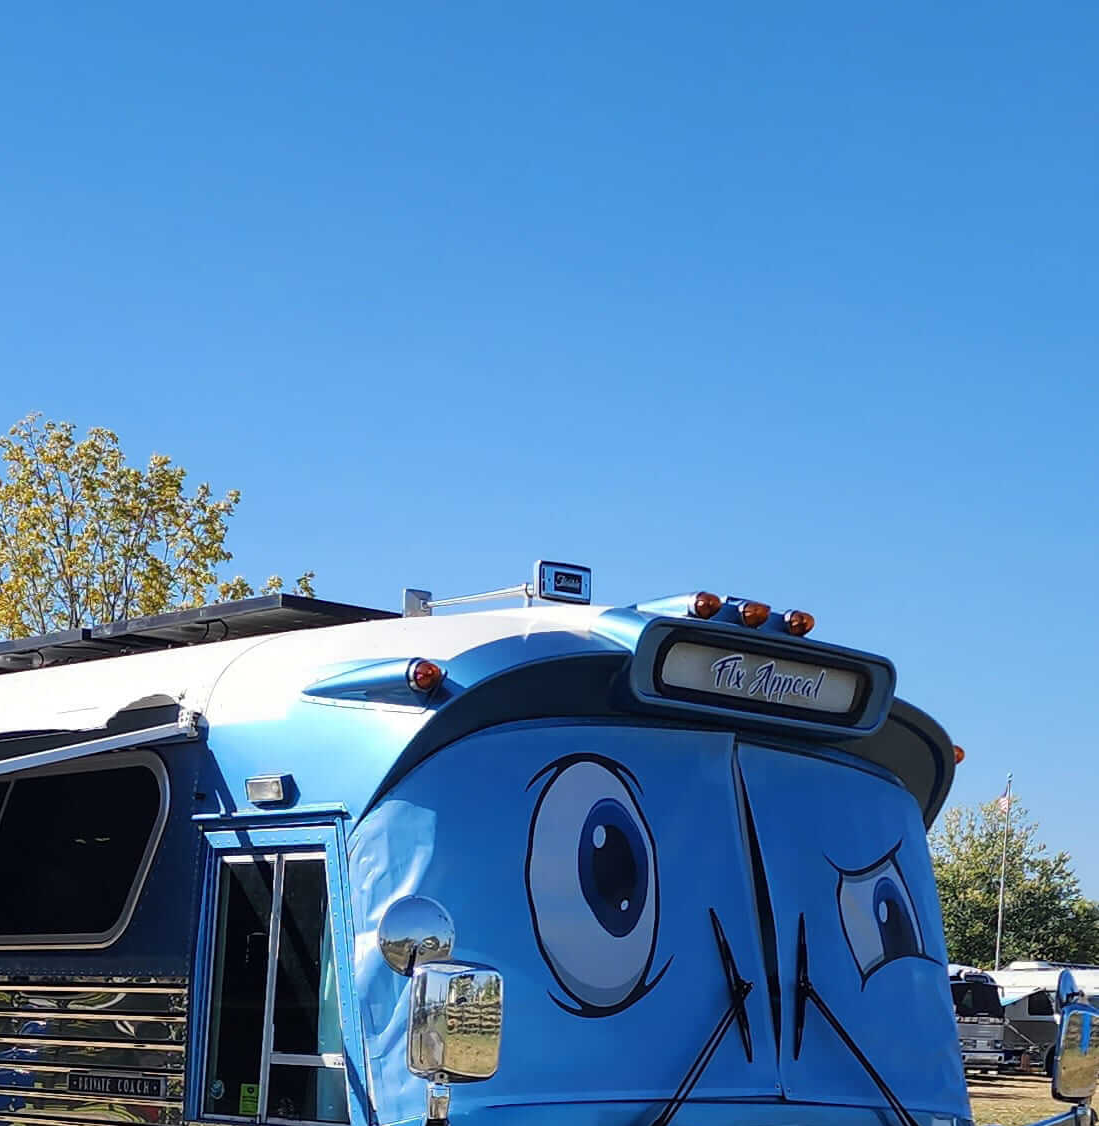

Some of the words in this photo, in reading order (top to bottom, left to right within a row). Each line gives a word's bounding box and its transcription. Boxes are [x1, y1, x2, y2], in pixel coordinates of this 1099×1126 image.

[711, 654, 746, 688] Flx
[749, 661, 826, 703] Appeal
[79, 1076, 111, 1092] PRIVATE
[117, 1079, 151, 1094] COACH
